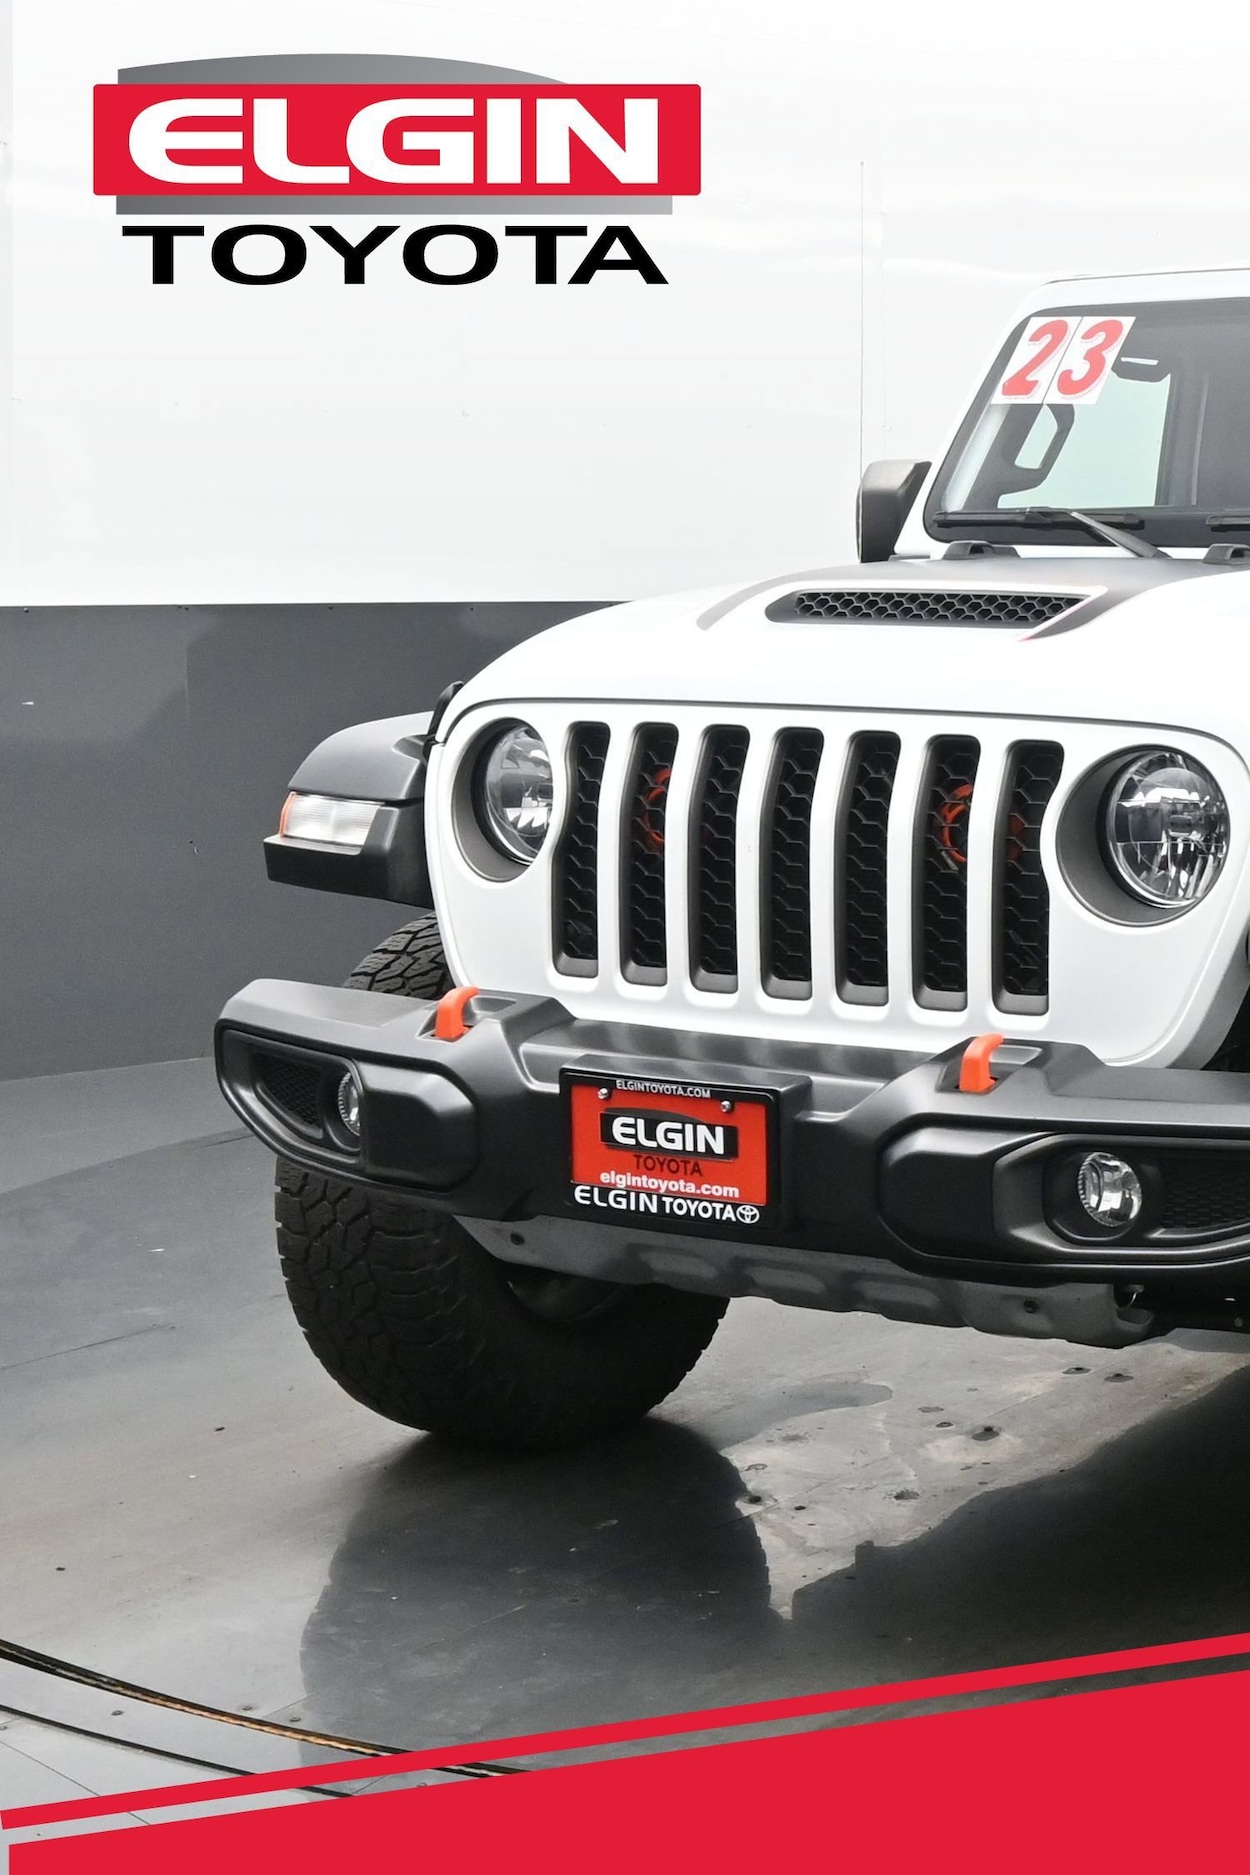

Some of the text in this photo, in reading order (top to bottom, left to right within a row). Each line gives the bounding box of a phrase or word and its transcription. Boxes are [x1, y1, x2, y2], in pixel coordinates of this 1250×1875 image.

[1002, 320, 1123, 395] 23
[616, 1079, 711, 1098] ELGINTOYOTA.COM
[612, 1116, 724, 1154] ELGIN
[633, 1154, 703, 1176] TOYOTA
[600, 1170, 740, 1198] elgintoyota.com
[574, 1185, 737, 1222] ELGIN TOYOTA
